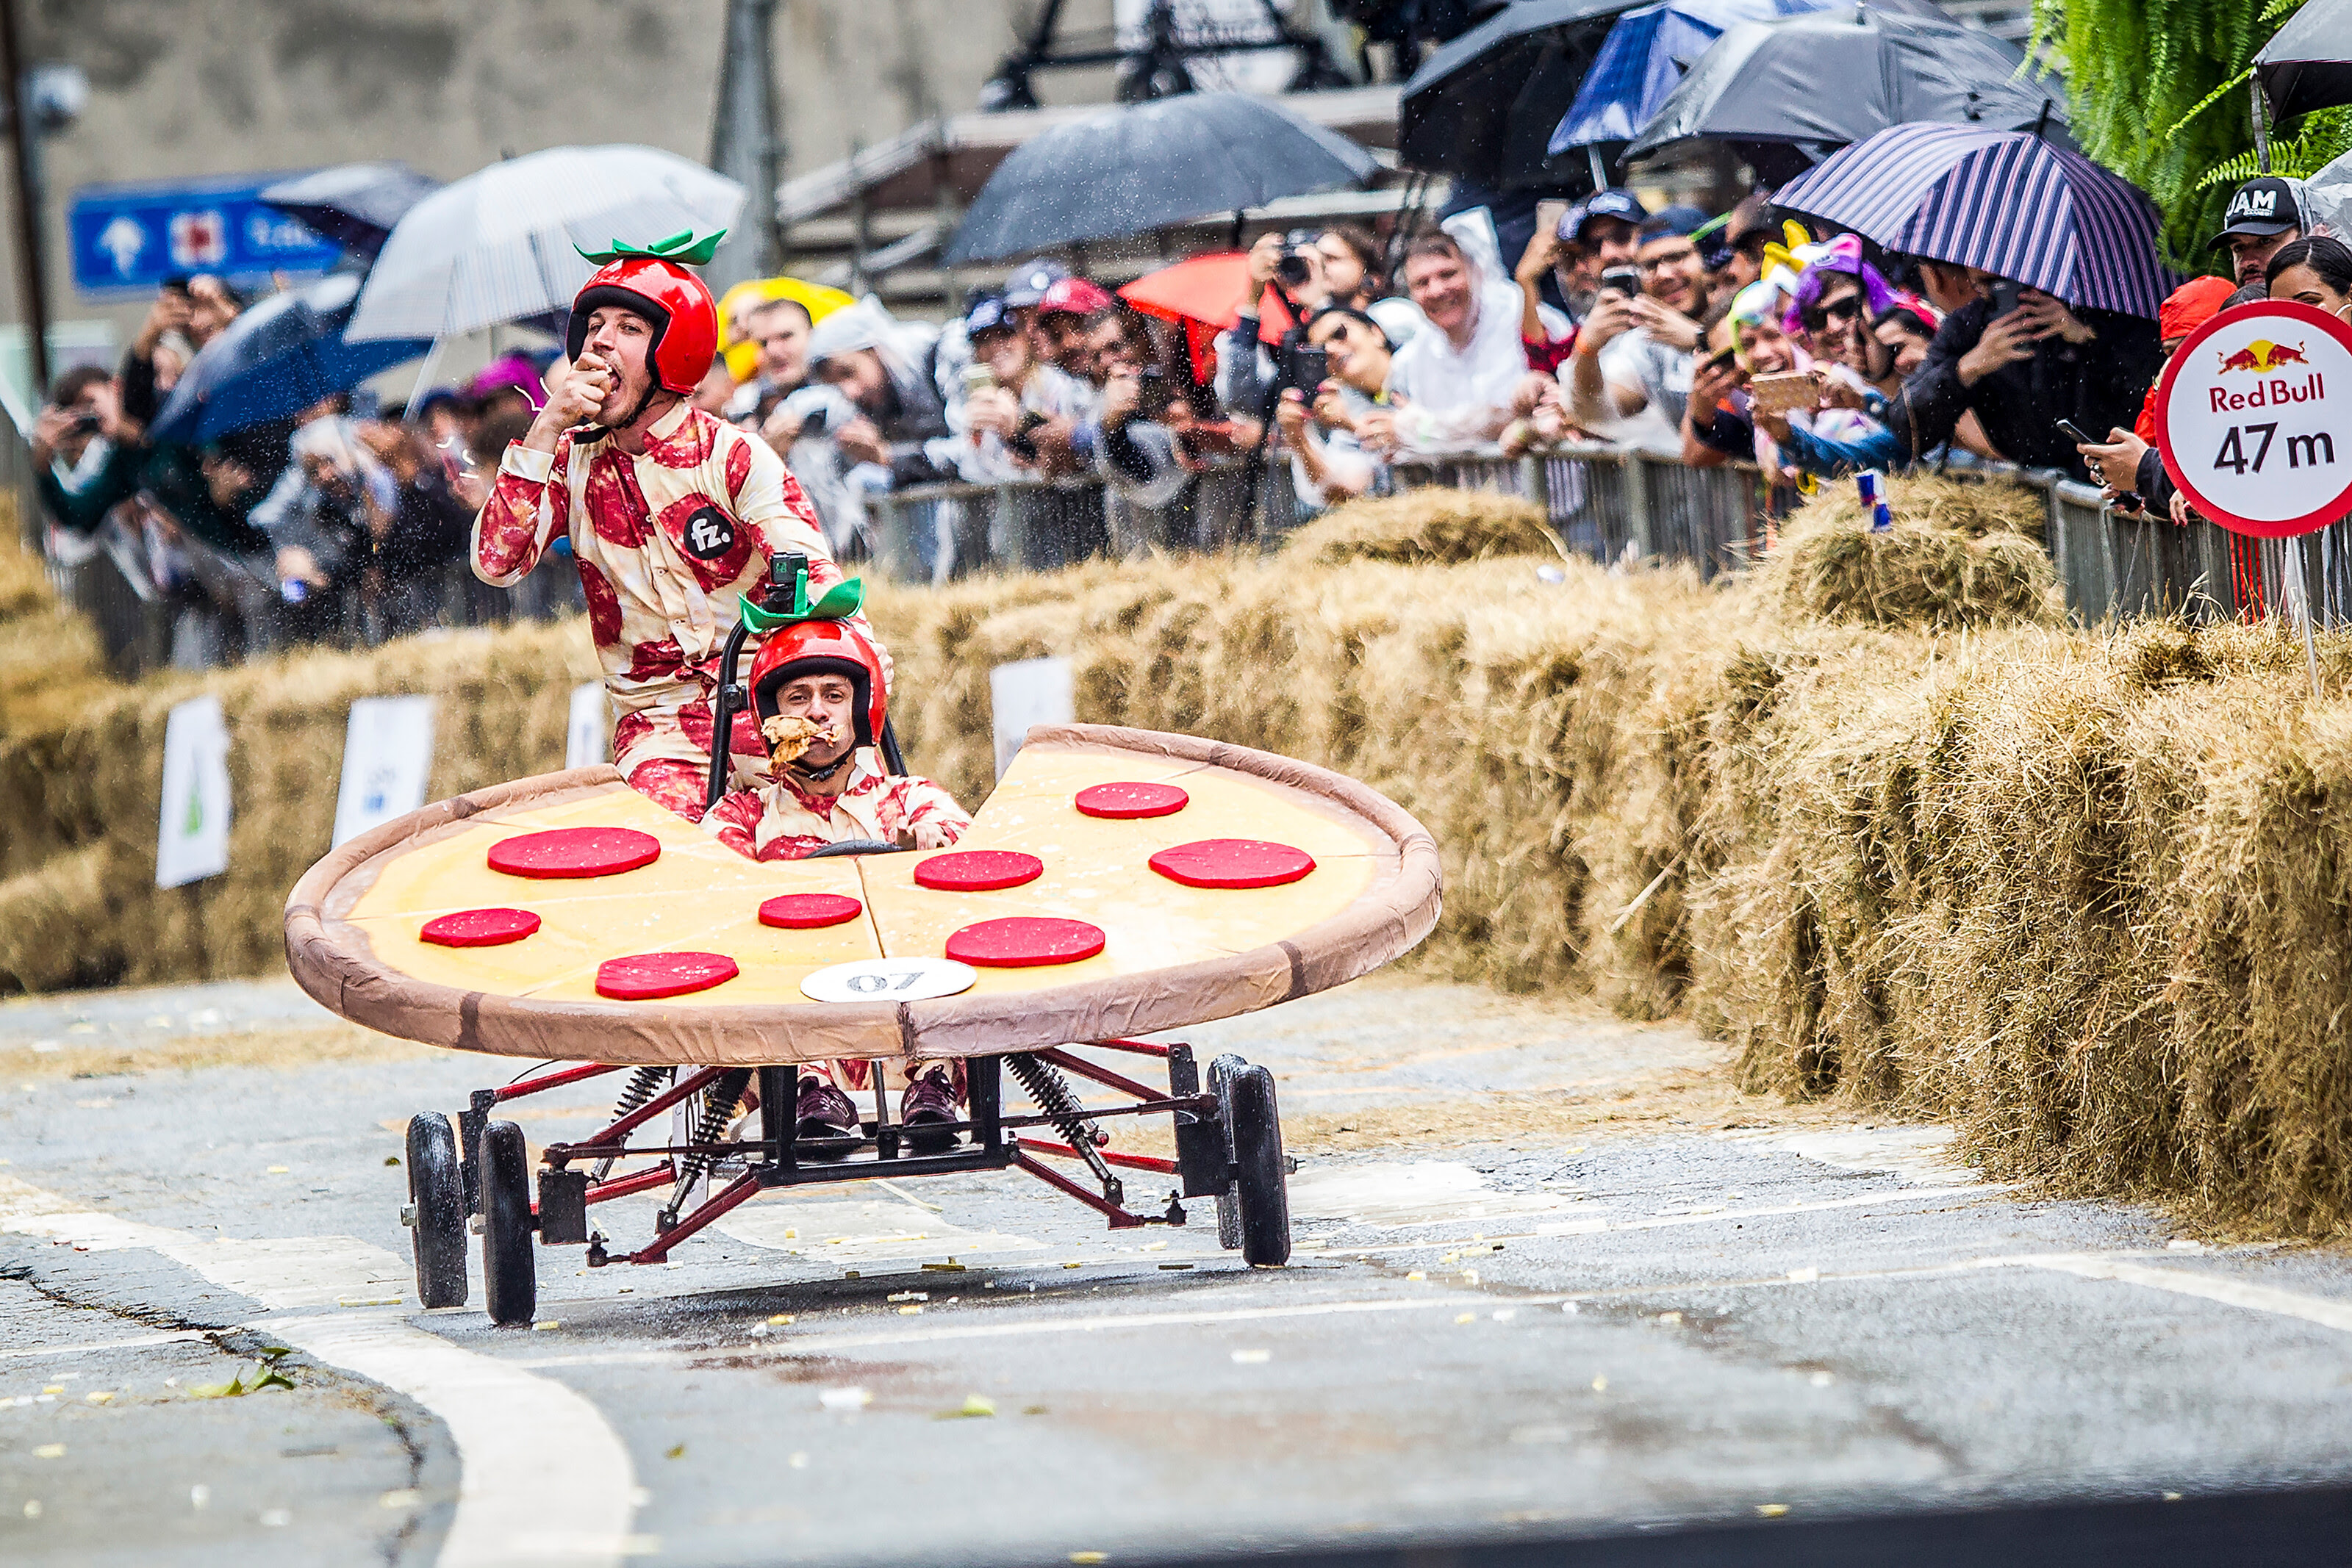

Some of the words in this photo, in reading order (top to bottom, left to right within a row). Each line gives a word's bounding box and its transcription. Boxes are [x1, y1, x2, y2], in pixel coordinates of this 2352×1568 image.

[2209, 380, 2266, 413] Red
[2270, 373, 2325, 406] Bull
[2213, 422, 2278, 475] 47
[2287, 432, 2335, 469] m
[847, 971, 925, 993] 07
